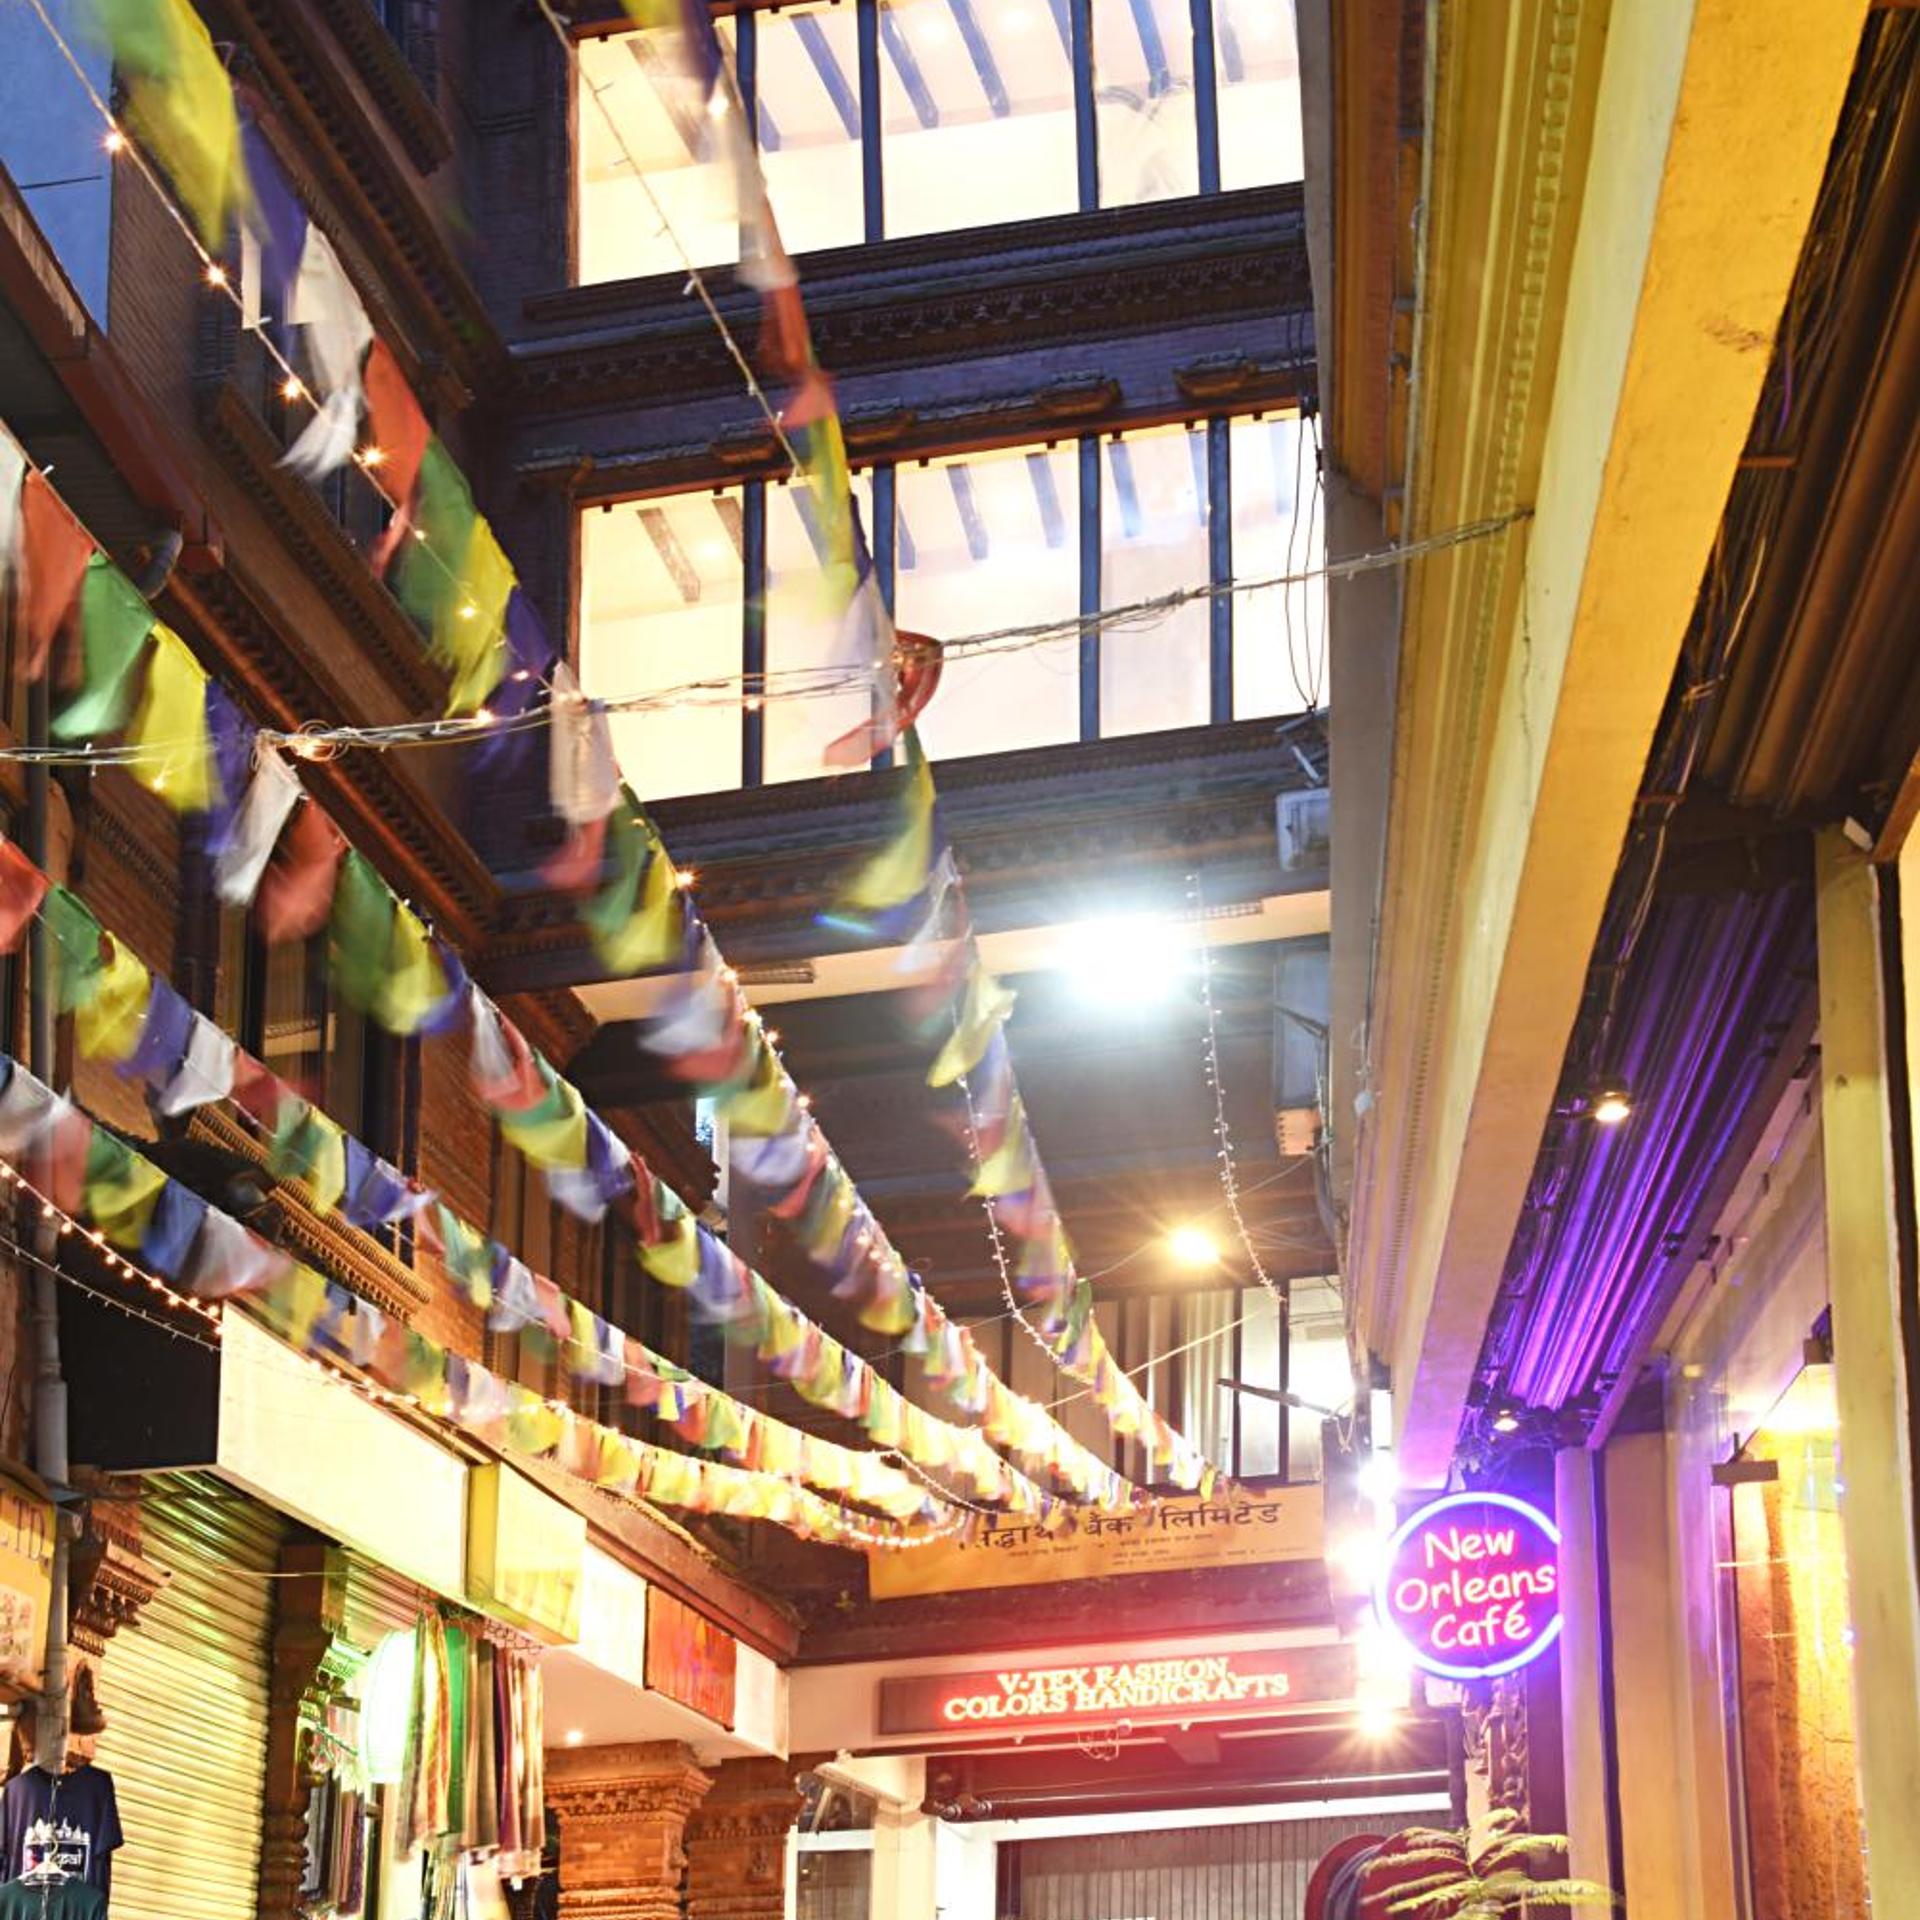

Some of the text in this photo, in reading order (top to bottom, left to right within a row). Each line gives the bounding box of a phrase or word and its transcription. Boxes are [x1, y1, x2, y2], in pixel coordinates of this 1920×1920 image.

[1159, 1500, 1282, 1530] लिमिटेड
[1424, 1527, 1515, 1569] New
[1395, 1565, 1557, 1613] Orleans
[1430, 1600, 1532, 1649] Café
[944, 1673, 1290, 1721] COLORS HANDICRAFTS
[997, 1667, 1089, 1695] V-TEX
